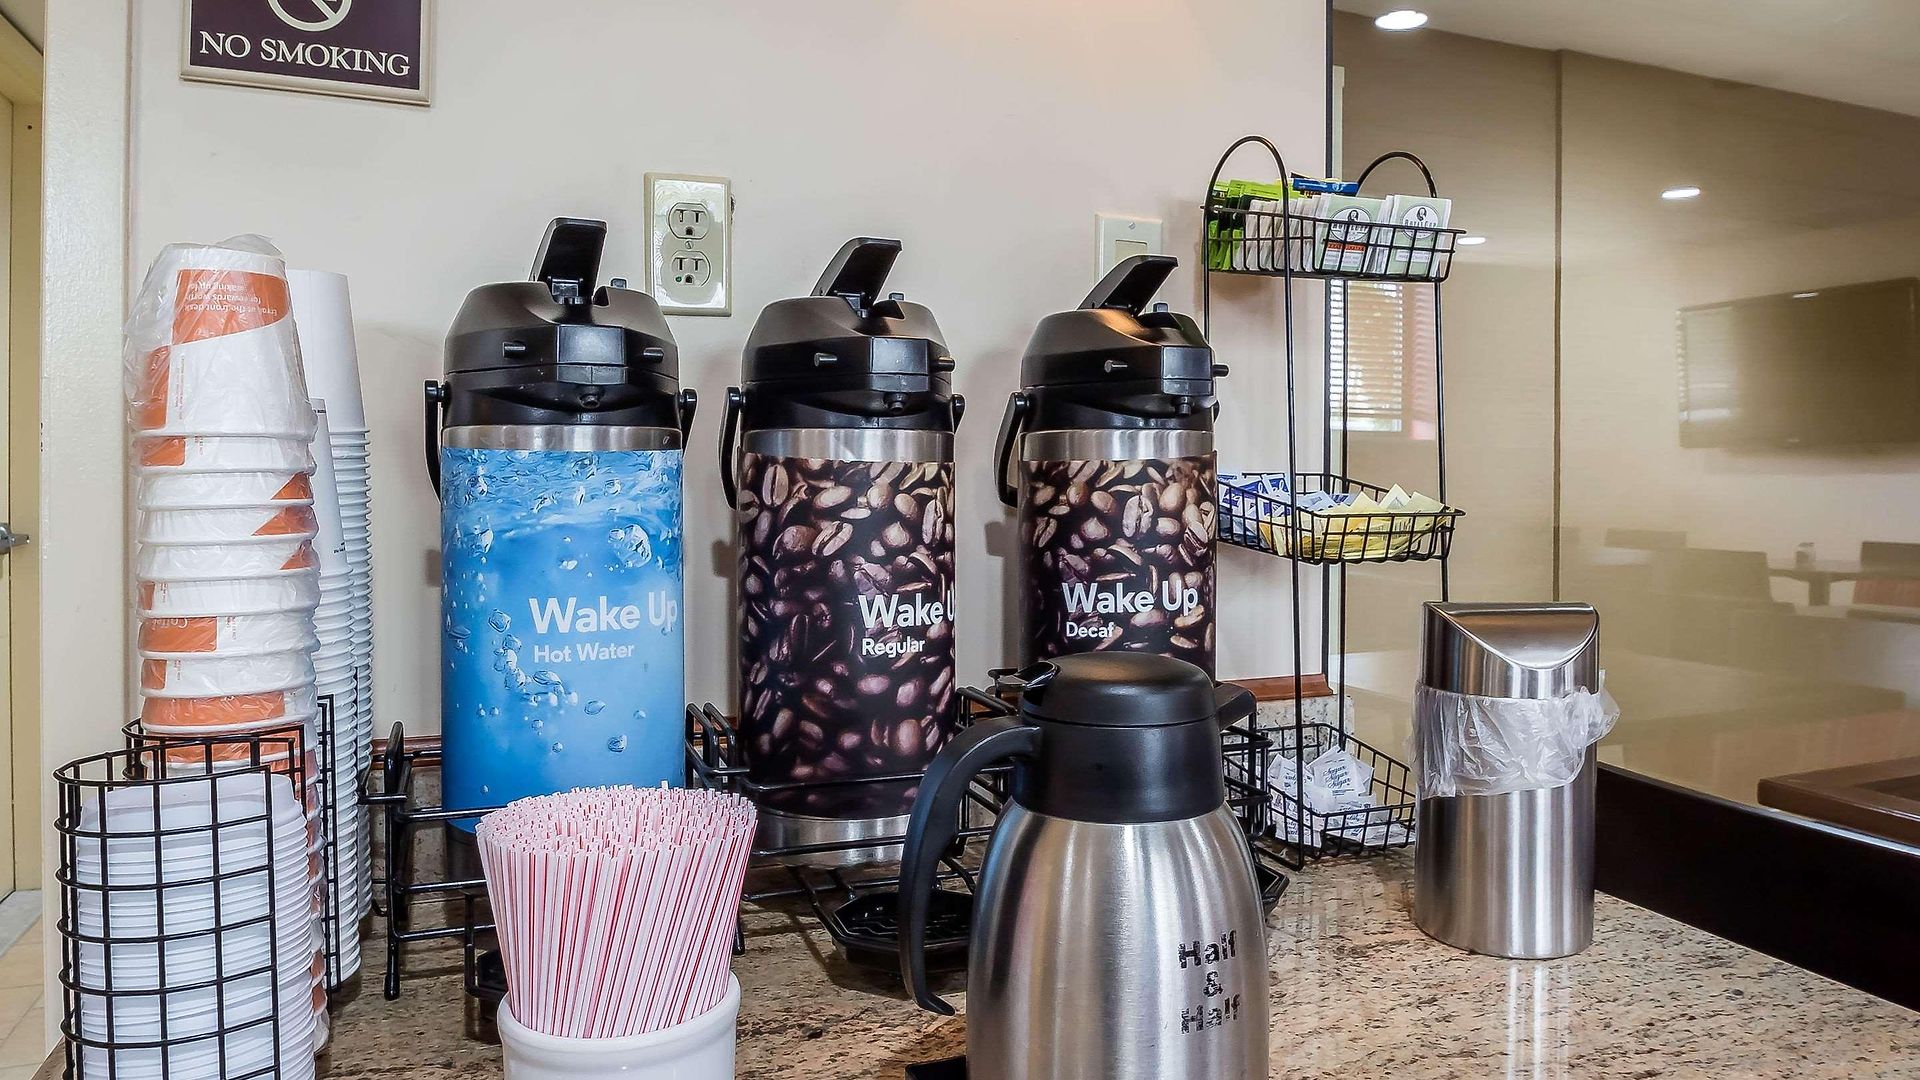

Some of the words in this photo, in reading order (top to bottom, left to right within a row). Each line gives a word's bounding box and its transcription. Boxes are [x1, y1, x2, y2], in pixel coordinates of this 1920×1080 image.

[200, 31, 251, 58] NO
[260, 38, 410, 76] SMOKING
[529, 596, 641, 634] Wake
[649, 590, 678, 632] Up
[858, 593, 944, 628] Wake
[1062, 583, 1154, 613] Wake
[1162, 580, 1198, 616] Up
[862, 636, 925, 658] Regular
[1066, 622, 1114, 637] Decaf
[534, 645, 572, 663] Hot
[576, 642, 634, 661] Water
[1178, 930, 1237, 969] Half
[1203, 971, 1224, 997] &
[1181, 994, 1240, 1034] Half
